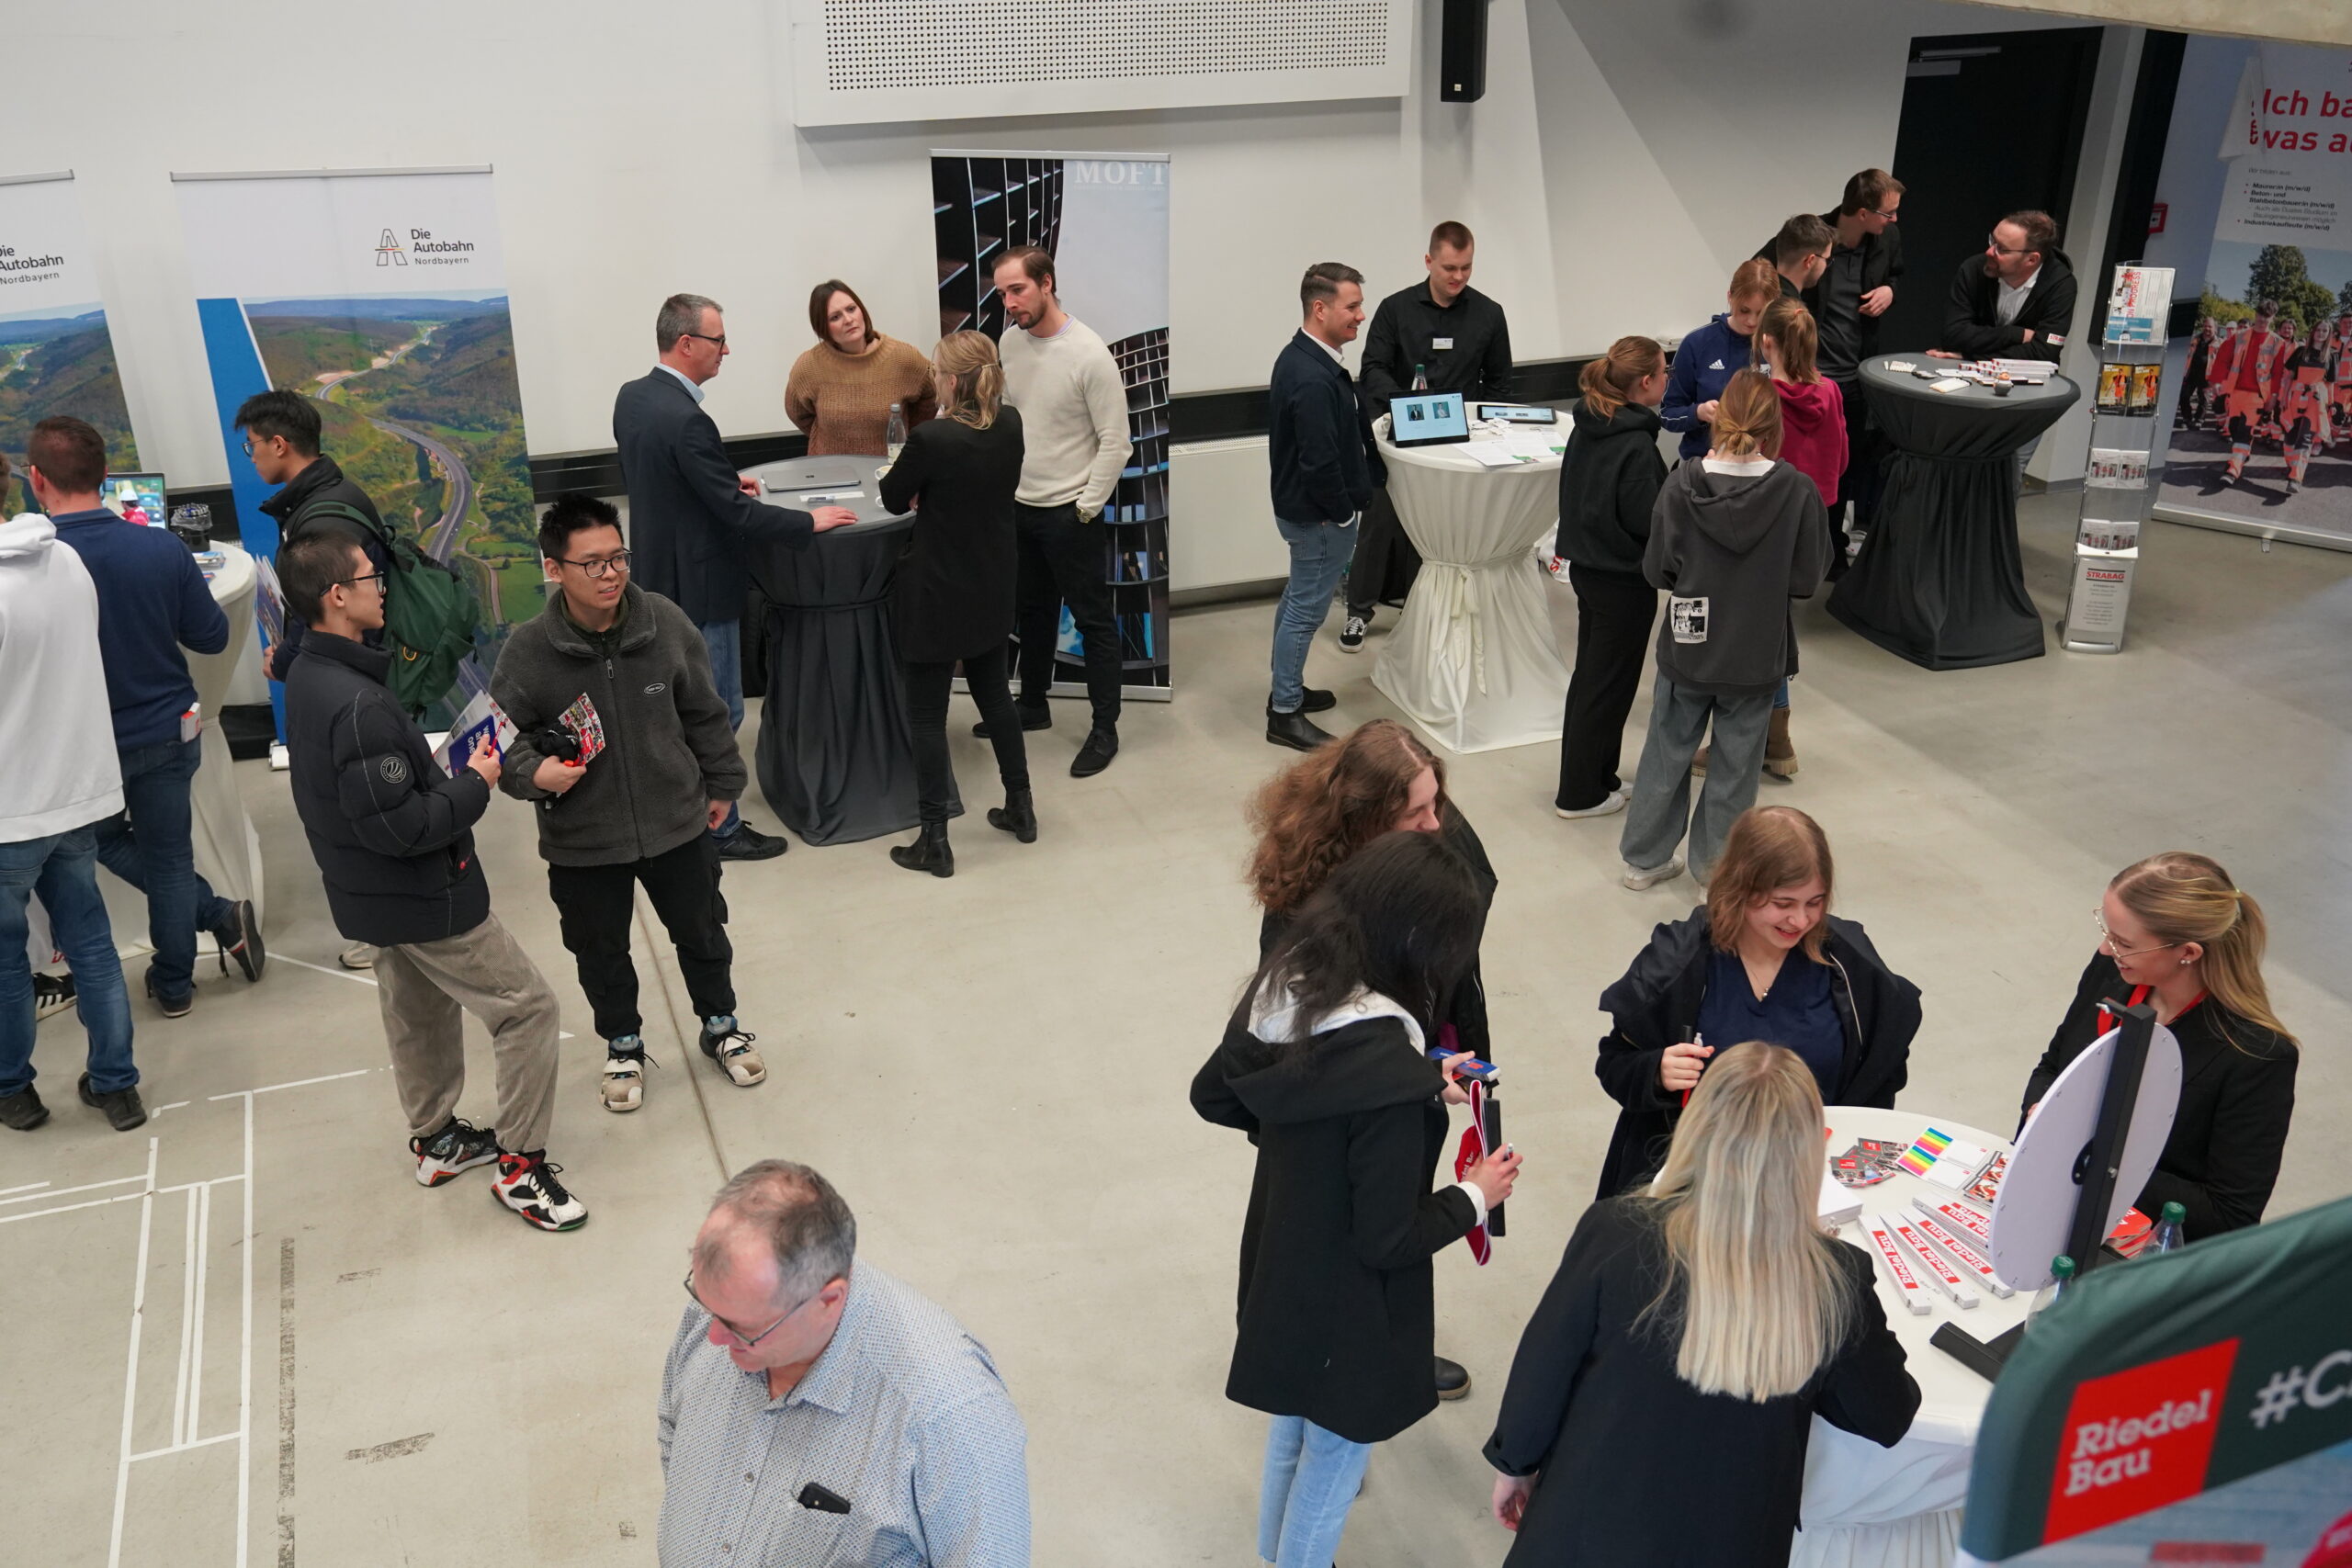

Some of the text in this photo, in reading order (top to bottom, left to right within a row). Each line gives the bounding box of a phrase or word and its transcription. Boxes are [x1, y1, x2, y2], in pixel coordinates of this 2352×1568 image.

[2263, 88, 2309, 116] Ich
[1073, 161, 1169, 185] MOFT
[411, 228, 431, 240] Die
[413, 241, 474, 253] Autobahn
[414, 256, 469, 265] Nordbayern
[0, 272, 60, 285] Nordbayern
[2086, 570, 2125, 580] STRABAG
[1905, 1231, 1925, 1250] Bau
[1927, 1224, 1984, 1269] Riedel Bau
[1878, 1235, 1915, 1287] Riedel Bau
[1922, 1248, 1952, 1280] Riedel
[2249, 1349, 2352, 1429] #C
[2071, 1388, 2212, 1460] Riedel
[2064, 1448, 2152, 1497] Bau
